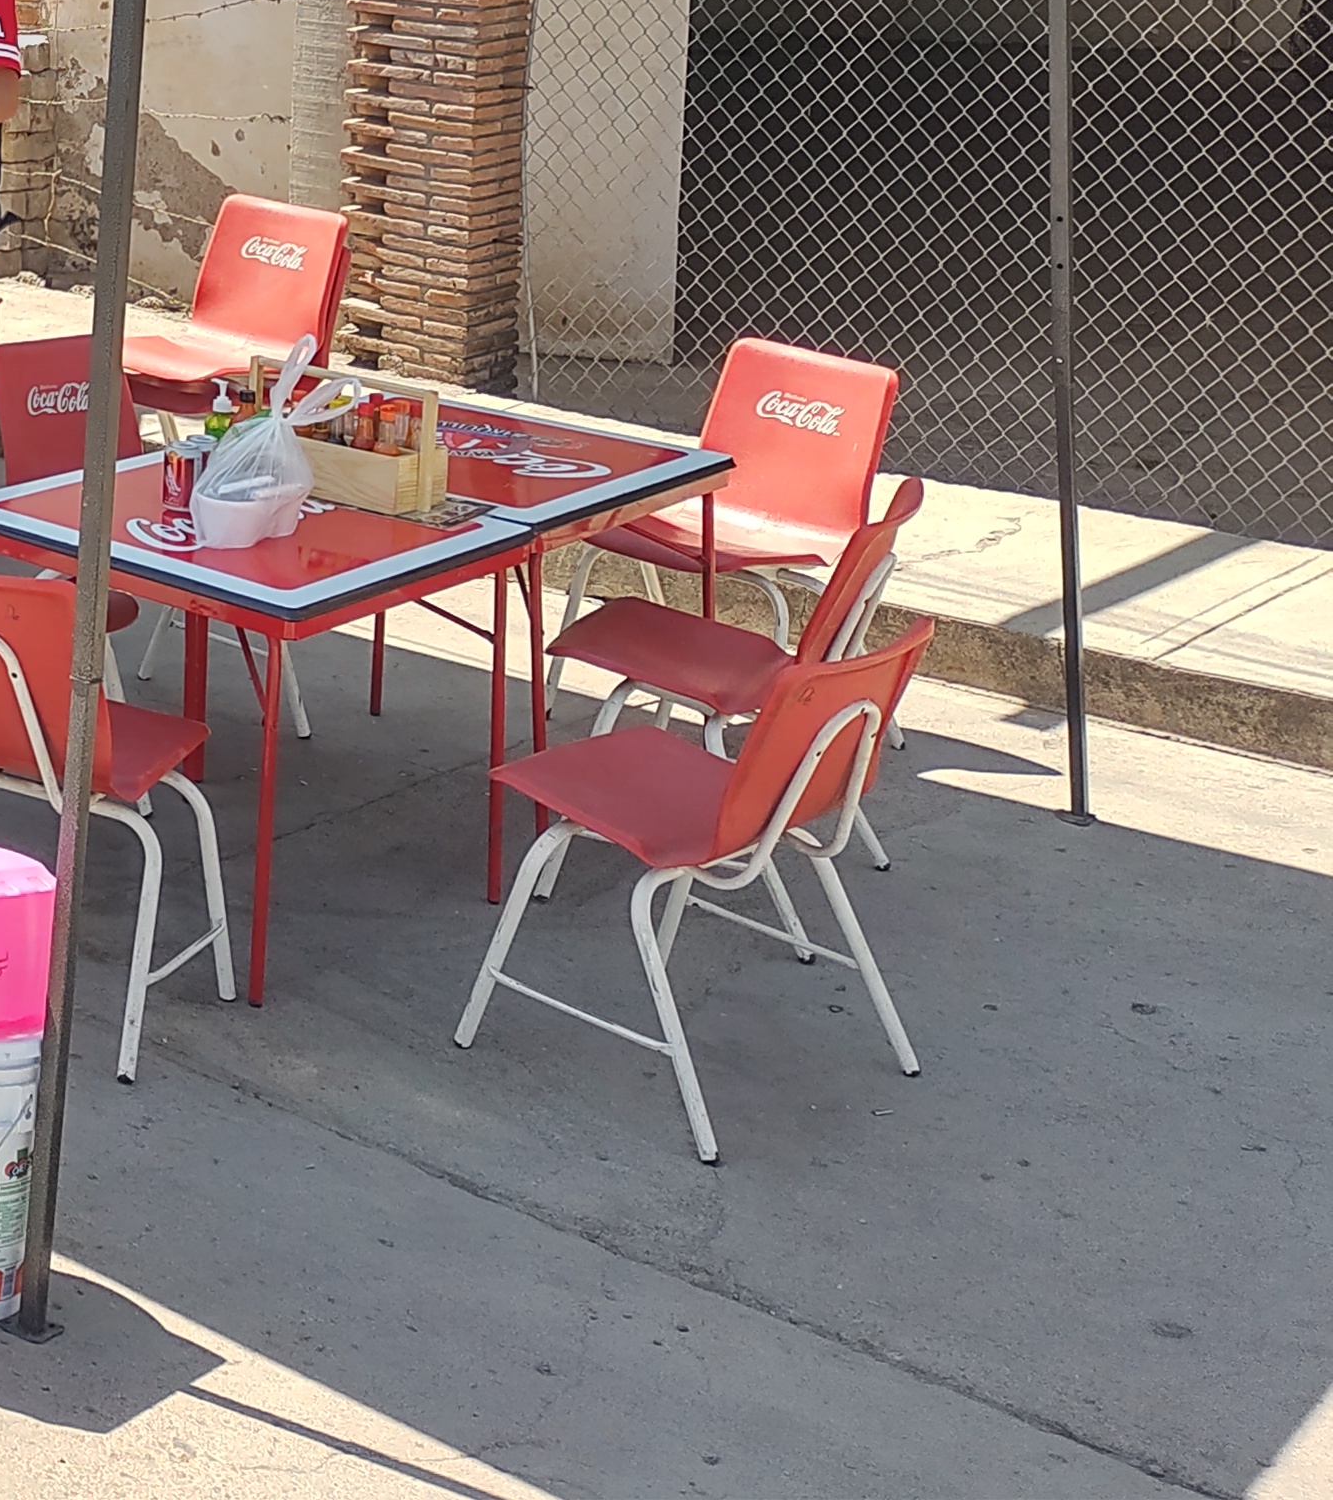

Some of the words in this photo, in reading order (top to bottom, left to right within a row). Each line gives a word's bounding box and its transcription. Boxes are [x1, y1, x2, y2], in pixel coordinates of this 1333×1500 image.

[240, 235, 308, 270] Coca-Cola
[27, 381, 90, 416] Coca-Cola
[756, 390, 846, 435] Coca-Cola
